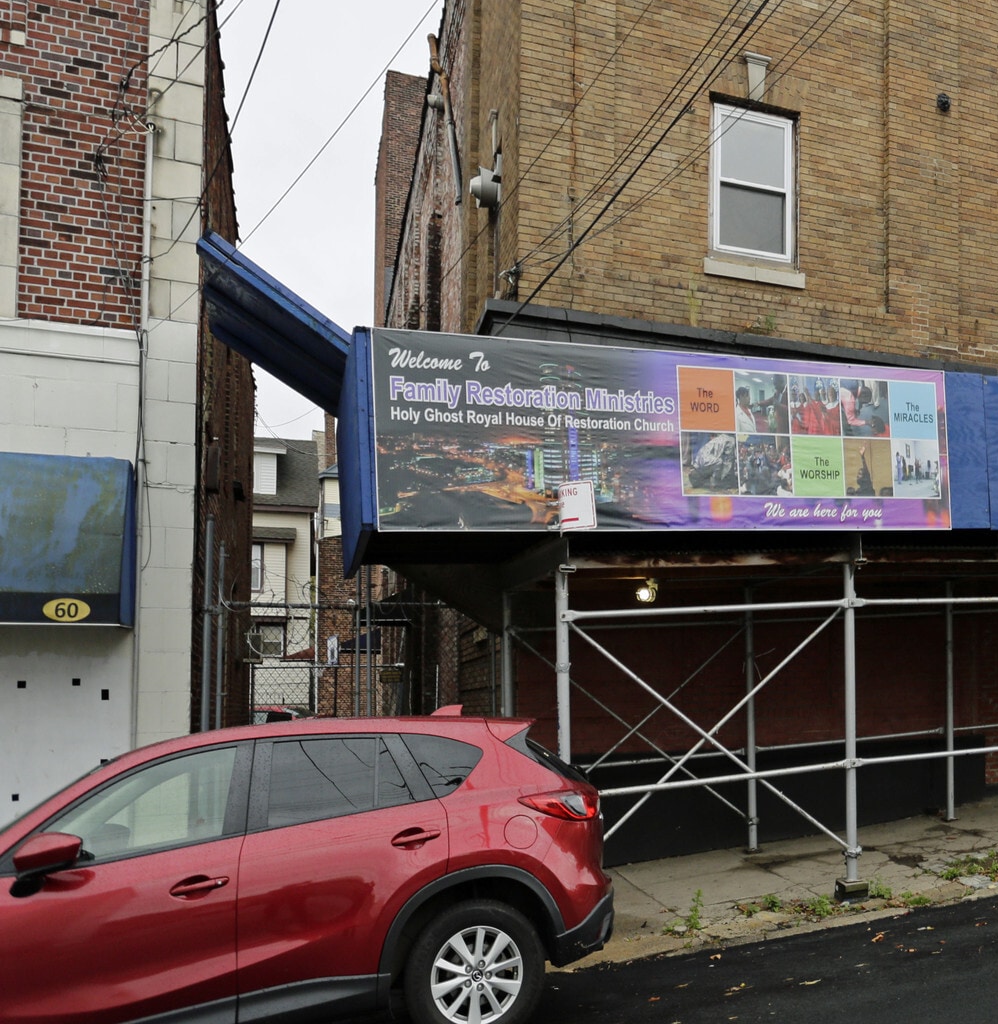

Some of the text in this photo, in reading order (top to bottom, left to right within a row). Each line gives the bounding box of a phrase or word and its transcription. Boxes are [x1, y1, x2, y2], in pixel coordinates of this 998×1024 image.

[388, 347, 491, 372] Welcome To
[390, 376, 675, 414] Family Restoration Ministries
[697, 387, 713, 398] The
[690, 402, 720, 413] WORD
[906, 402, 919, 412] The
[390, 406, 674, 432] Holy Ghost Royal House Of Restoration Church
[894, 413, 934, 423] MIRACLES
[814, 457, 830, 467] The
[800, 469, 840, 480] WORSHIP
[764, 502, 882, 522] We are here for you
[54, 602, 78, 618] 60
